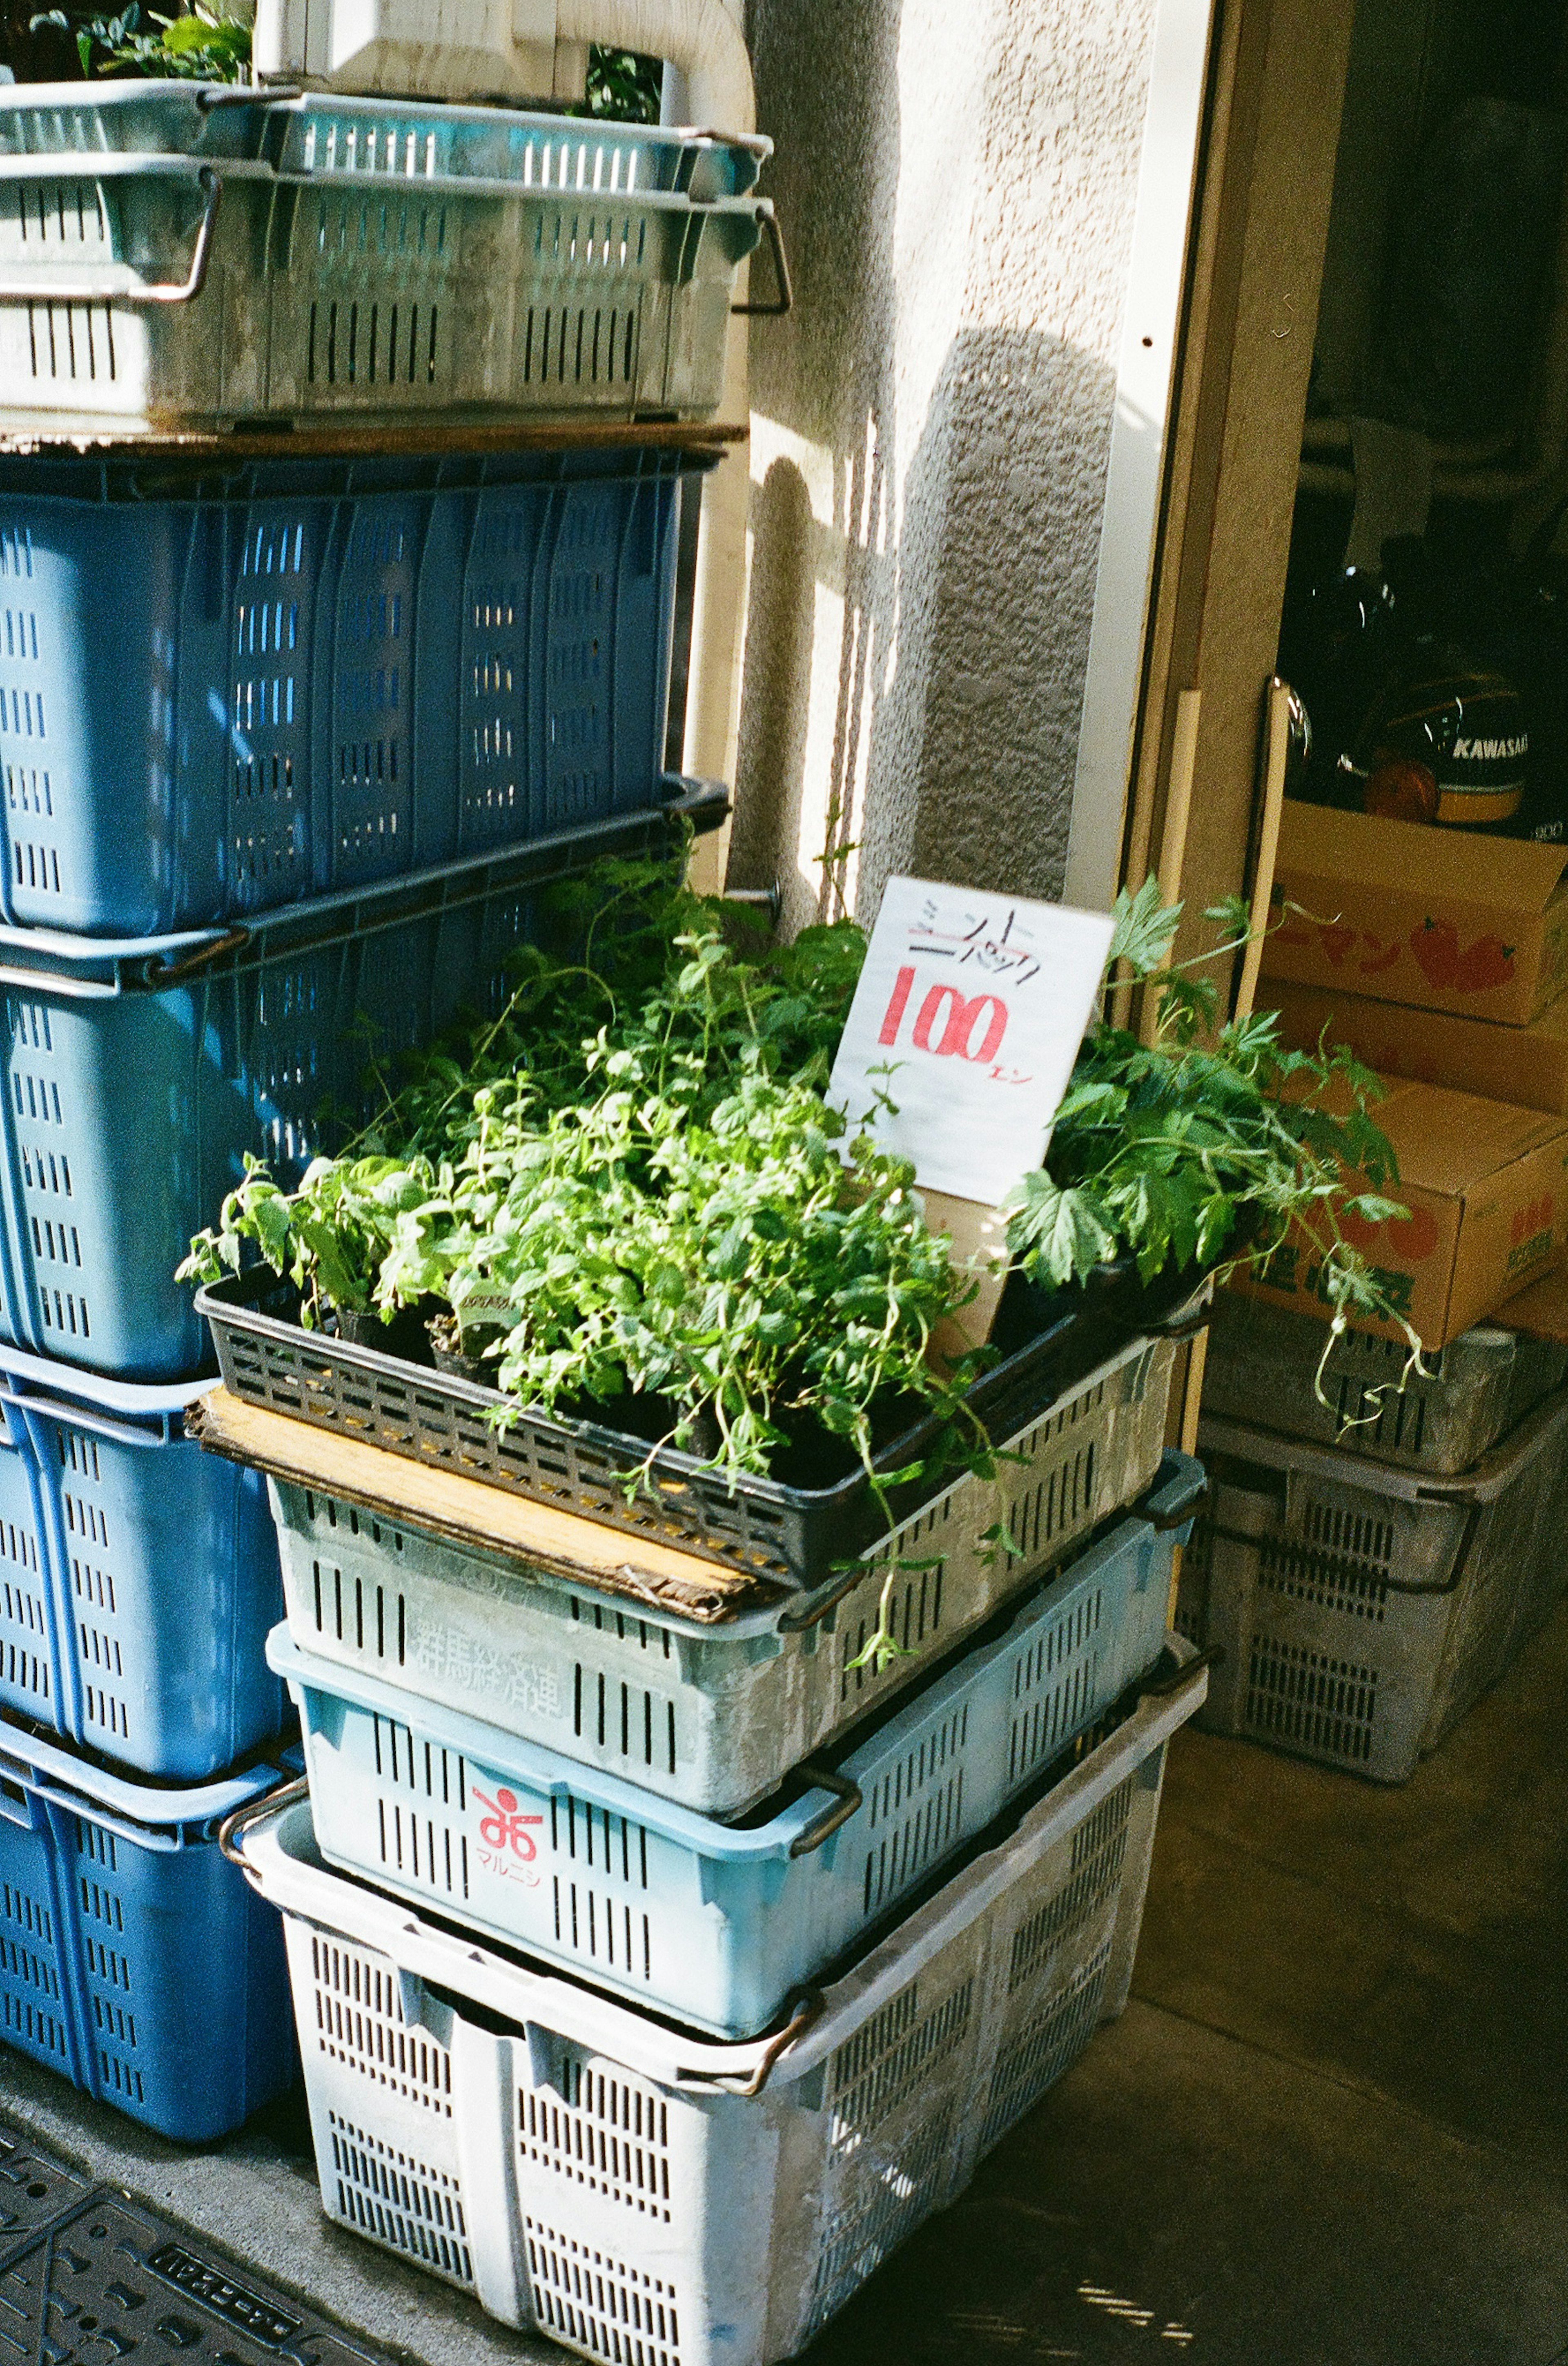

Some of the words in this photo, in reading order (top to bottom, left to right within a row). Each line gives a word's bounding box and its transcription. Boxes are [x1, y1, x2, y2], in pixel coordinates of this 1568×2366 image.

[918, 899, 1034, 945] ミント
[1267, 921, 1401, 974] ーマン
[878, 966, 1009, 1064] 100
[987, 1064, 1034, 1085] エン
[476, 1847, 541, 1888] マルニシ
